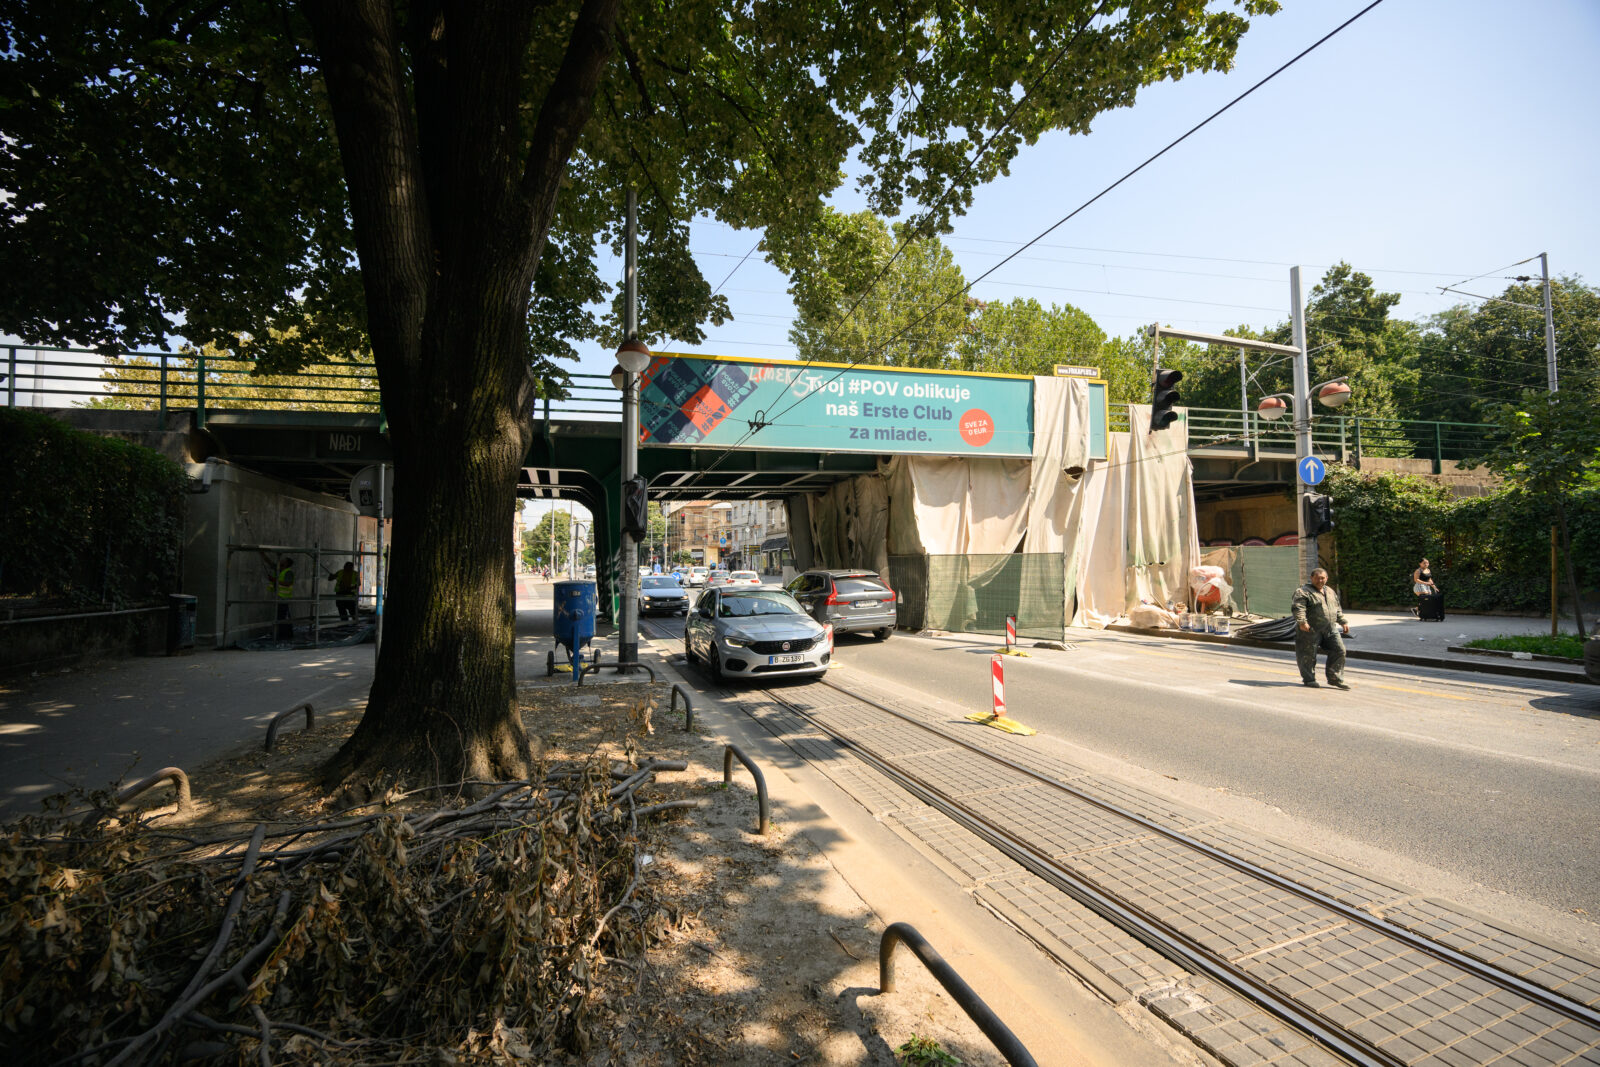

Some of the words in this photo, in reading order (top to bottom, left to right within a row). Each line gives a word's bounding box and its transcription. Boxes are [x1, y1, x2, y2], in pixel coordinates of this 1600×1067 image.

[806, 376, 845, 396] Tvoj
[848, 379, 899, 396] #POV
[903, 383, 971, 403] oblikuje
[826, 401, 859, 417] naš
[863, 402, 909, 419] Erste
[913, 404, 953, 421] Club
[964, 421, 977, 429] SVE
[978, 419, 988, 427] ZA
[974, 427, 987, 435] EUR
[849, 427, 870, 439] za
[874, 426, 932, 442] mlade.
